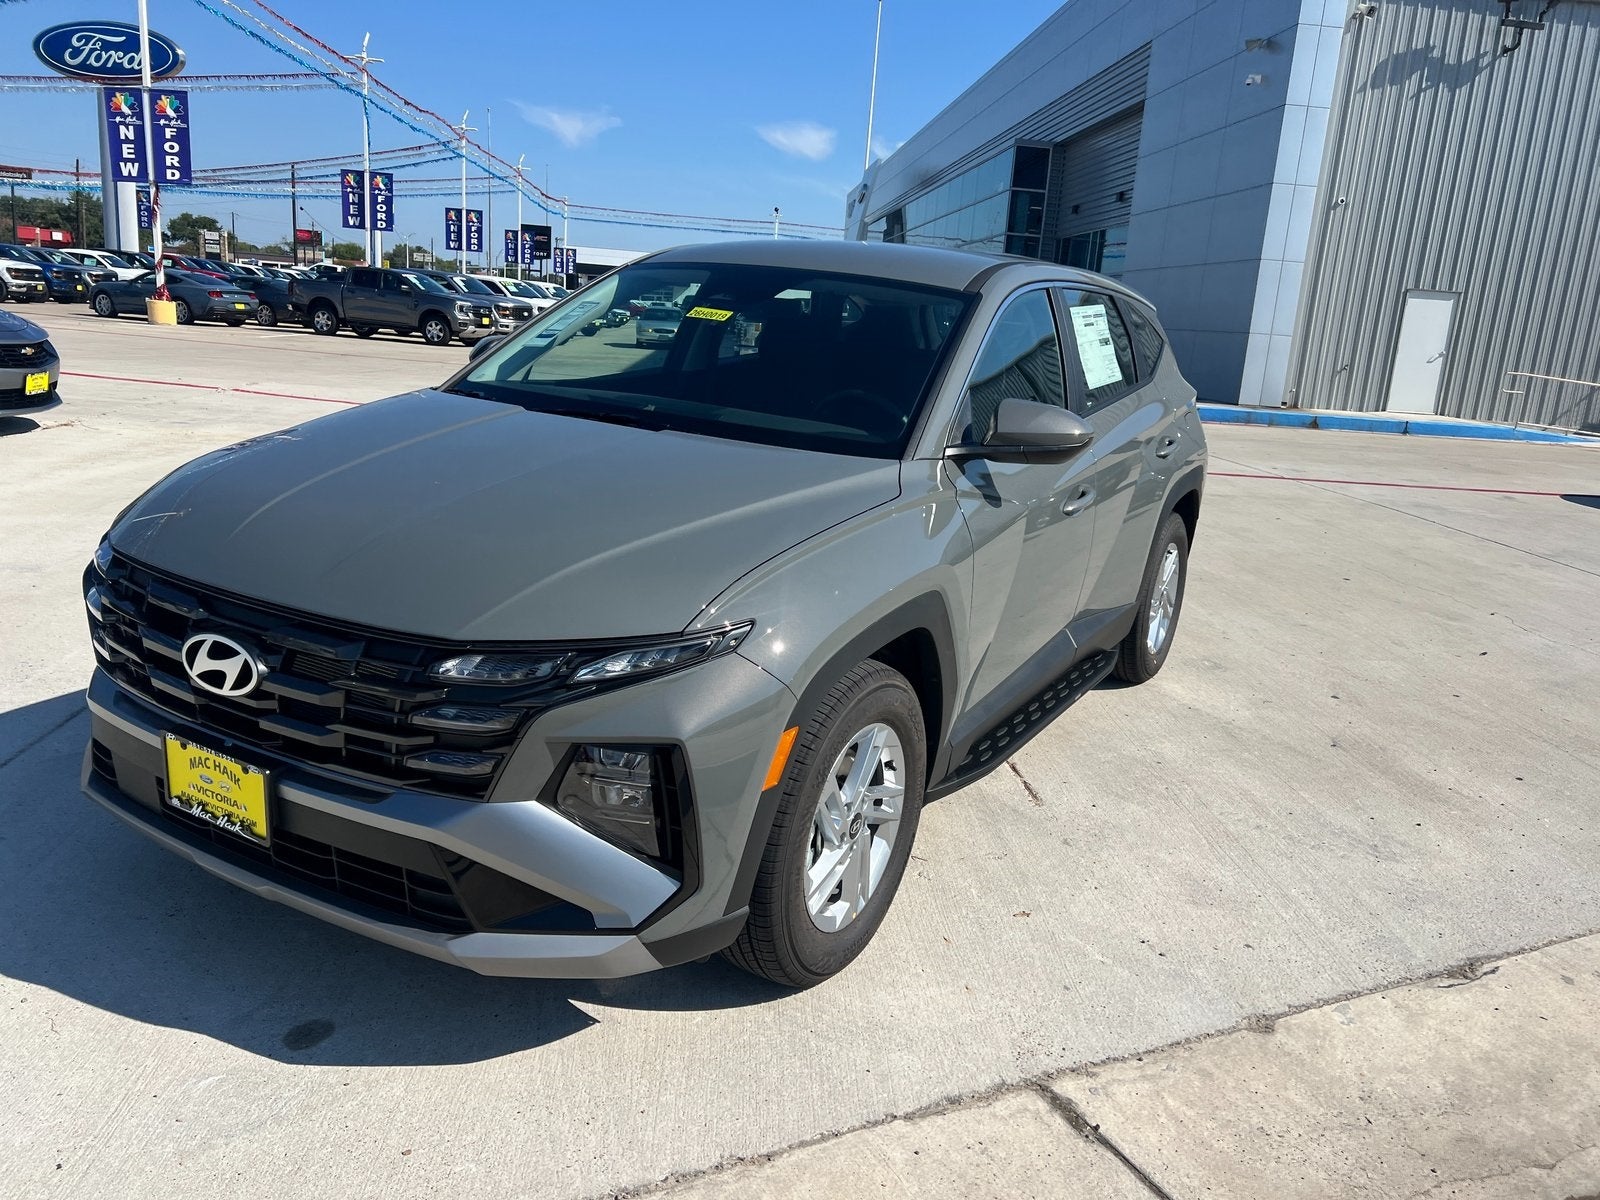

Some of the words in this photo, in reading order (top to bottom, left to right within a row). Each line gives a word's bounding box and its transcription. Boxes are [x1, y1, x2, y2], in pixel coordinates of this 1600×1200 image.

[64, 32, 148, 70] Ford
[119, 125, 139, 177] NEW
[163, 128, 181, 180] FORD
[140, 205, 148, 228] FORD
[347, 193, 360, 226] NEW
[376, 195, 387, 228] FORD
[449, 224, 459, 249] NEW
[470, 226, 478, 250] FORD
[689, 309, 728, 320] 26H0019
[189, 756, 210, 770] MAC
[213, 759, 241, 790] HAIK
[195, 783, 240, 809] VICTORIA
[190, 804, 215, 822] Mac
